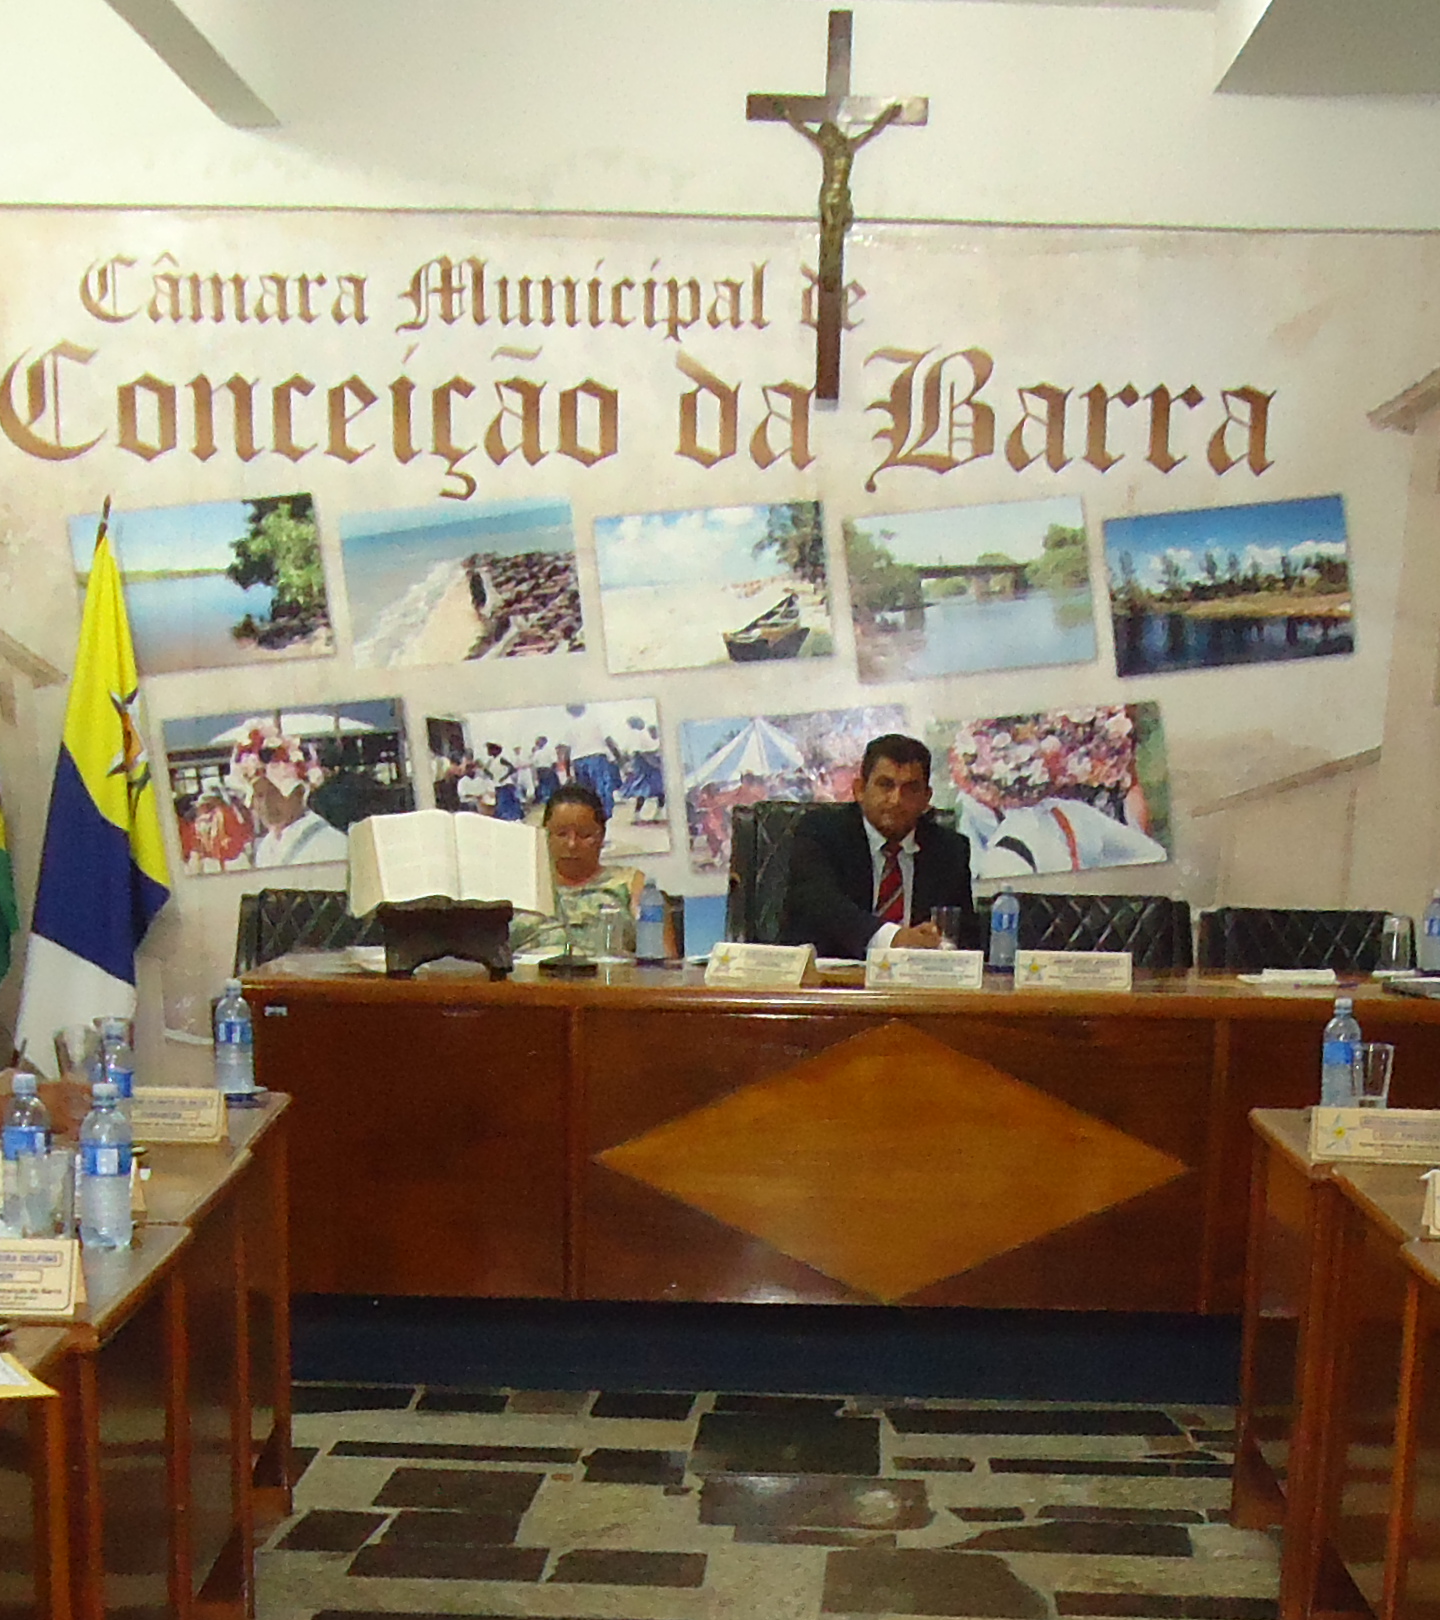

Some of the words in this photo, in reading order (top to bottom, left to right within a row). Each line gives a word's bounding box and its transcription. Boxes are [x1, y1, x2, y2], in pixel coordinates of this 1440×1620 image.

[79, 252, 368, 325] Câmara
[396, 255, 770, 342] Municipal
[674, 350, 816, 471] da
[863, 344, 1277, 493] Barra
